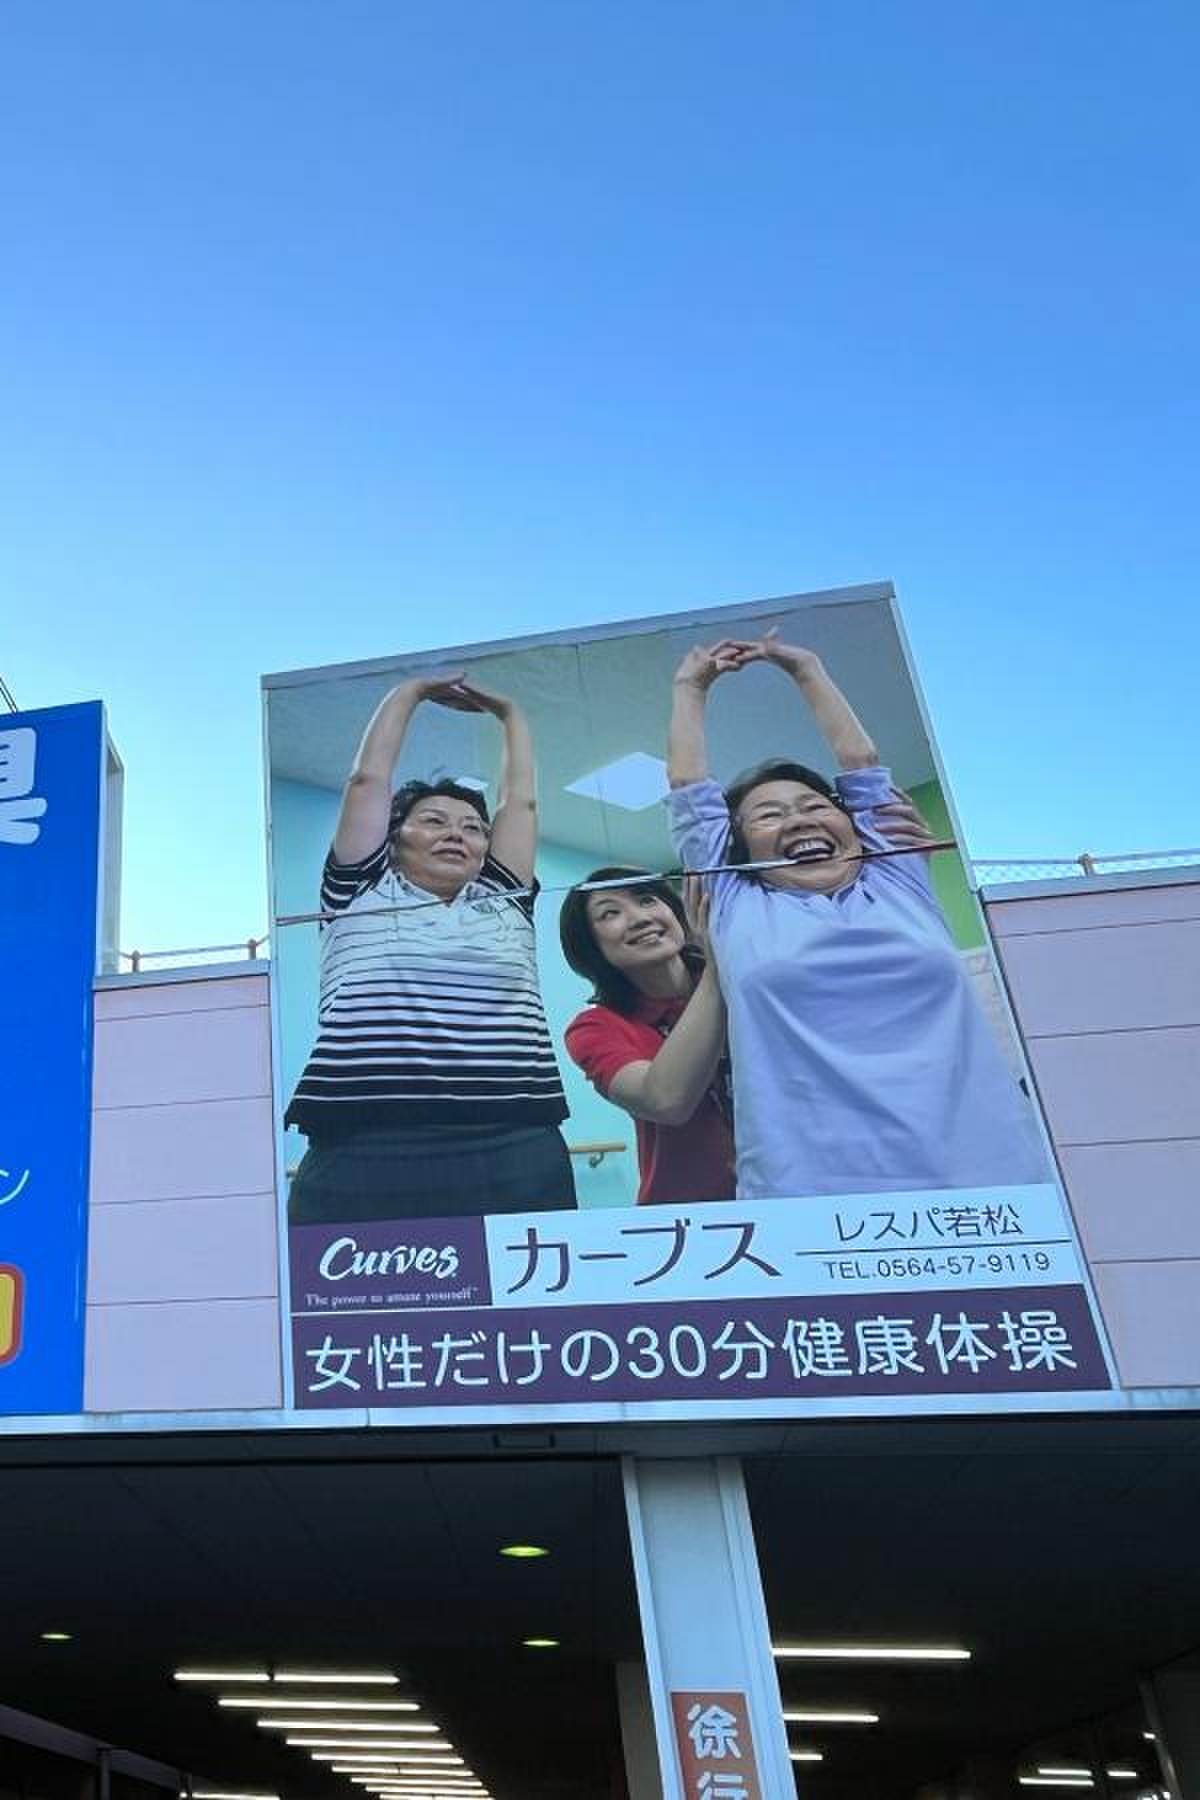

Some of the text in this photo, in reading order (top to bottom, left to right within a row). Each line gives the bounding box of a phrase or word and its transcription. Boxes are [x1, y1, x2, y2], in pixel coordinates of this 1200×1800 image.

[834, 1203, 1024, 1242] レスパ若松
[319, 1236, 460, 1282] Curves
[504, 1218, 782, 1295] カーブス
[823, 1251, 1051, 1280] TEL.0564-57-9119
[305, 1293, 329, 1306] The
[305, 1310, 1077, 1392] 女性だけの30分健康体操
